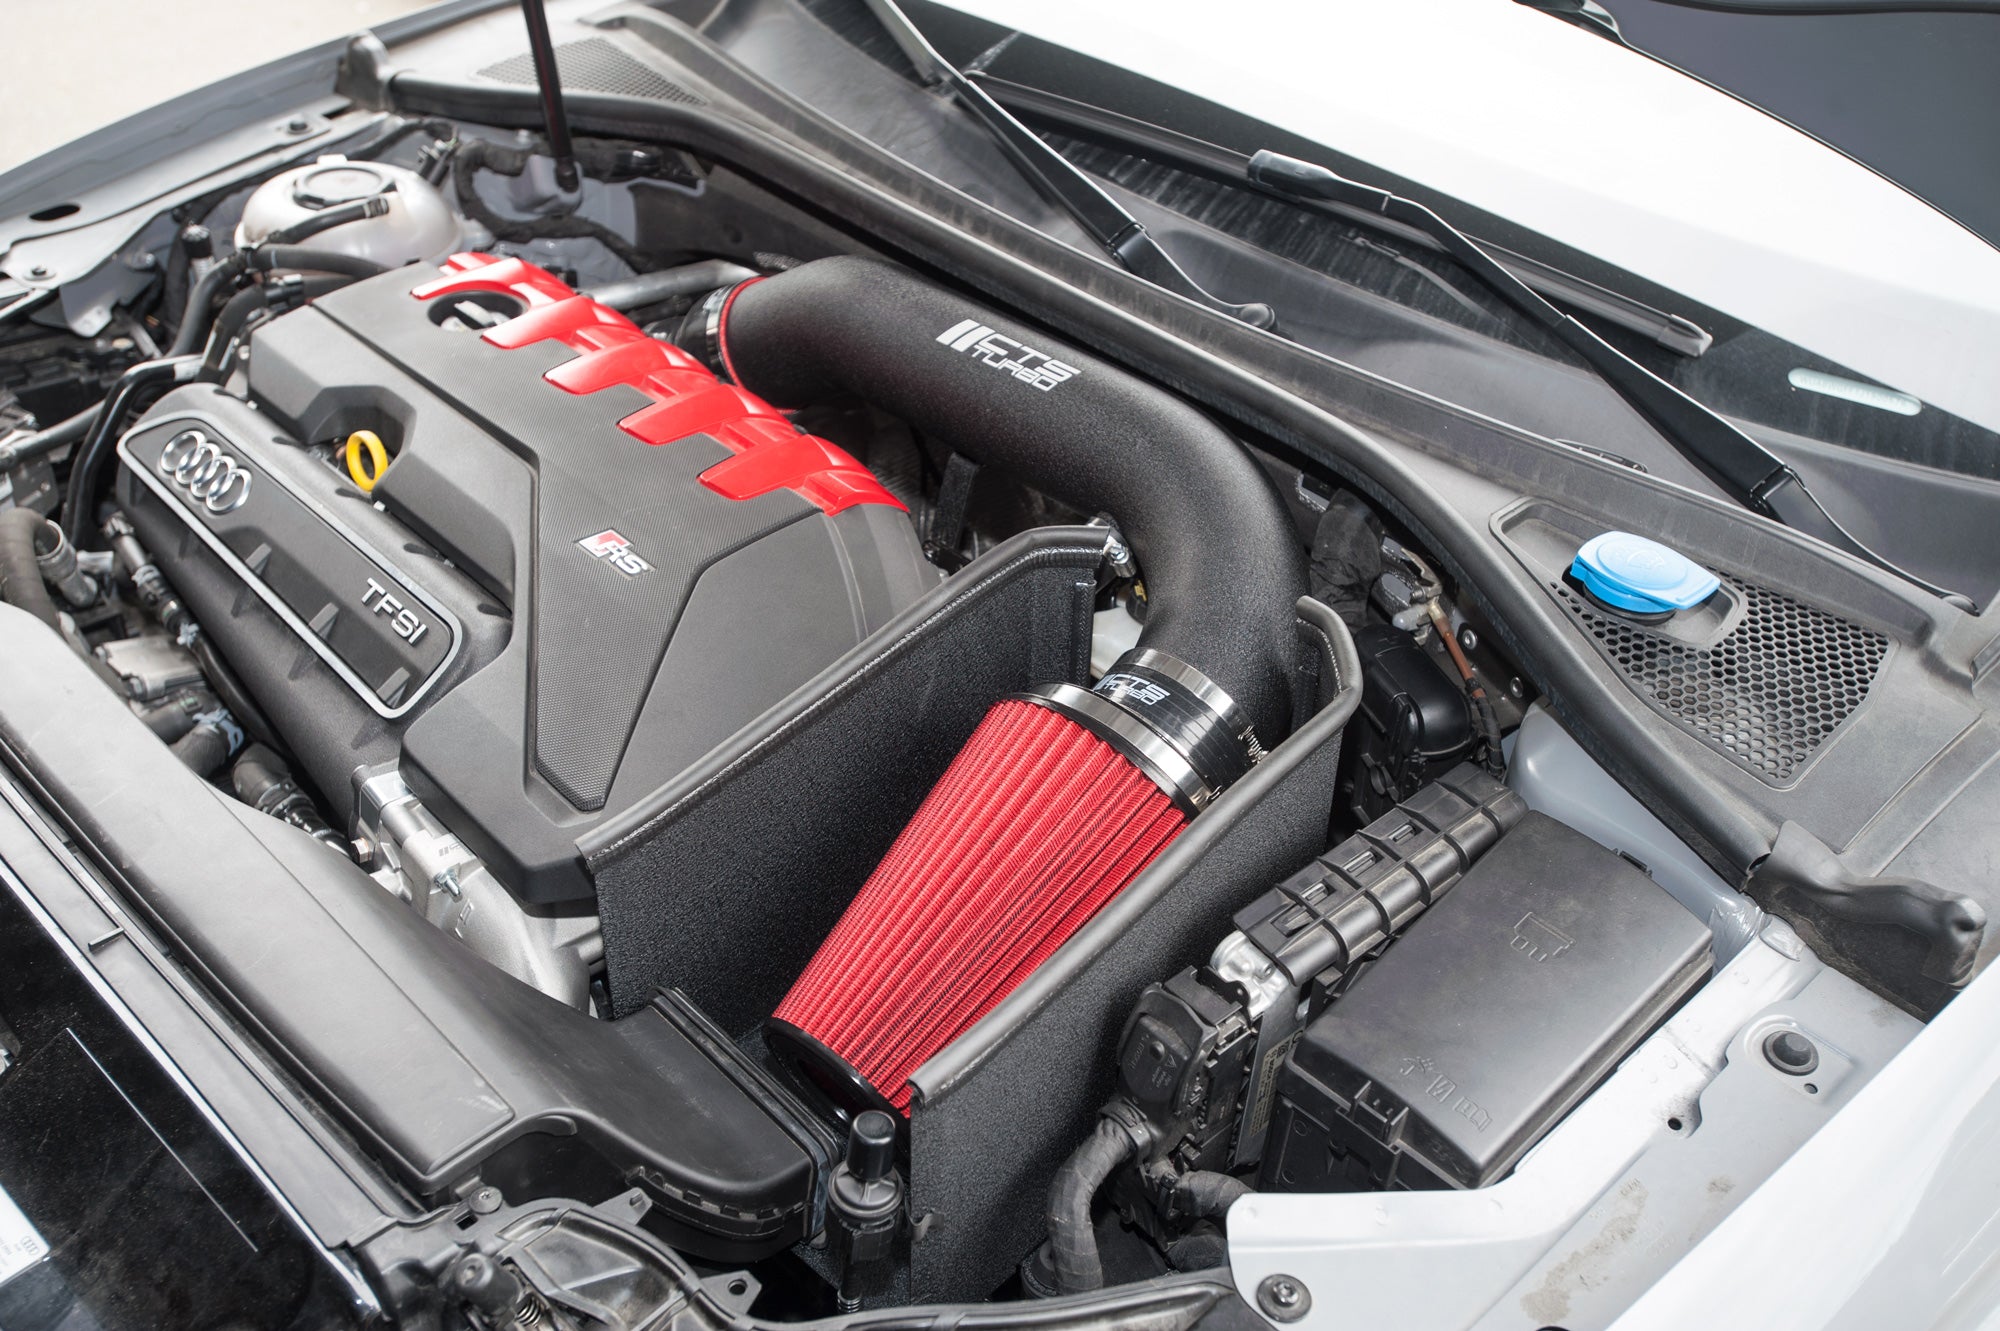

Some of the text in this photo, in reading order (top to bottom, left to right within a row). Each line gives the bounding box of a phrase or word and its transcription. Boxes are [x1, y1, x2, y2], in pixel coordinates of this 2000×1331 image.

[972, 344, 1058, 392] TURBO
[978, 333, 1082, 382] CTS
[361, 577, 427, 645] TFSI
[1108, 673, 1171, 701] CTS
